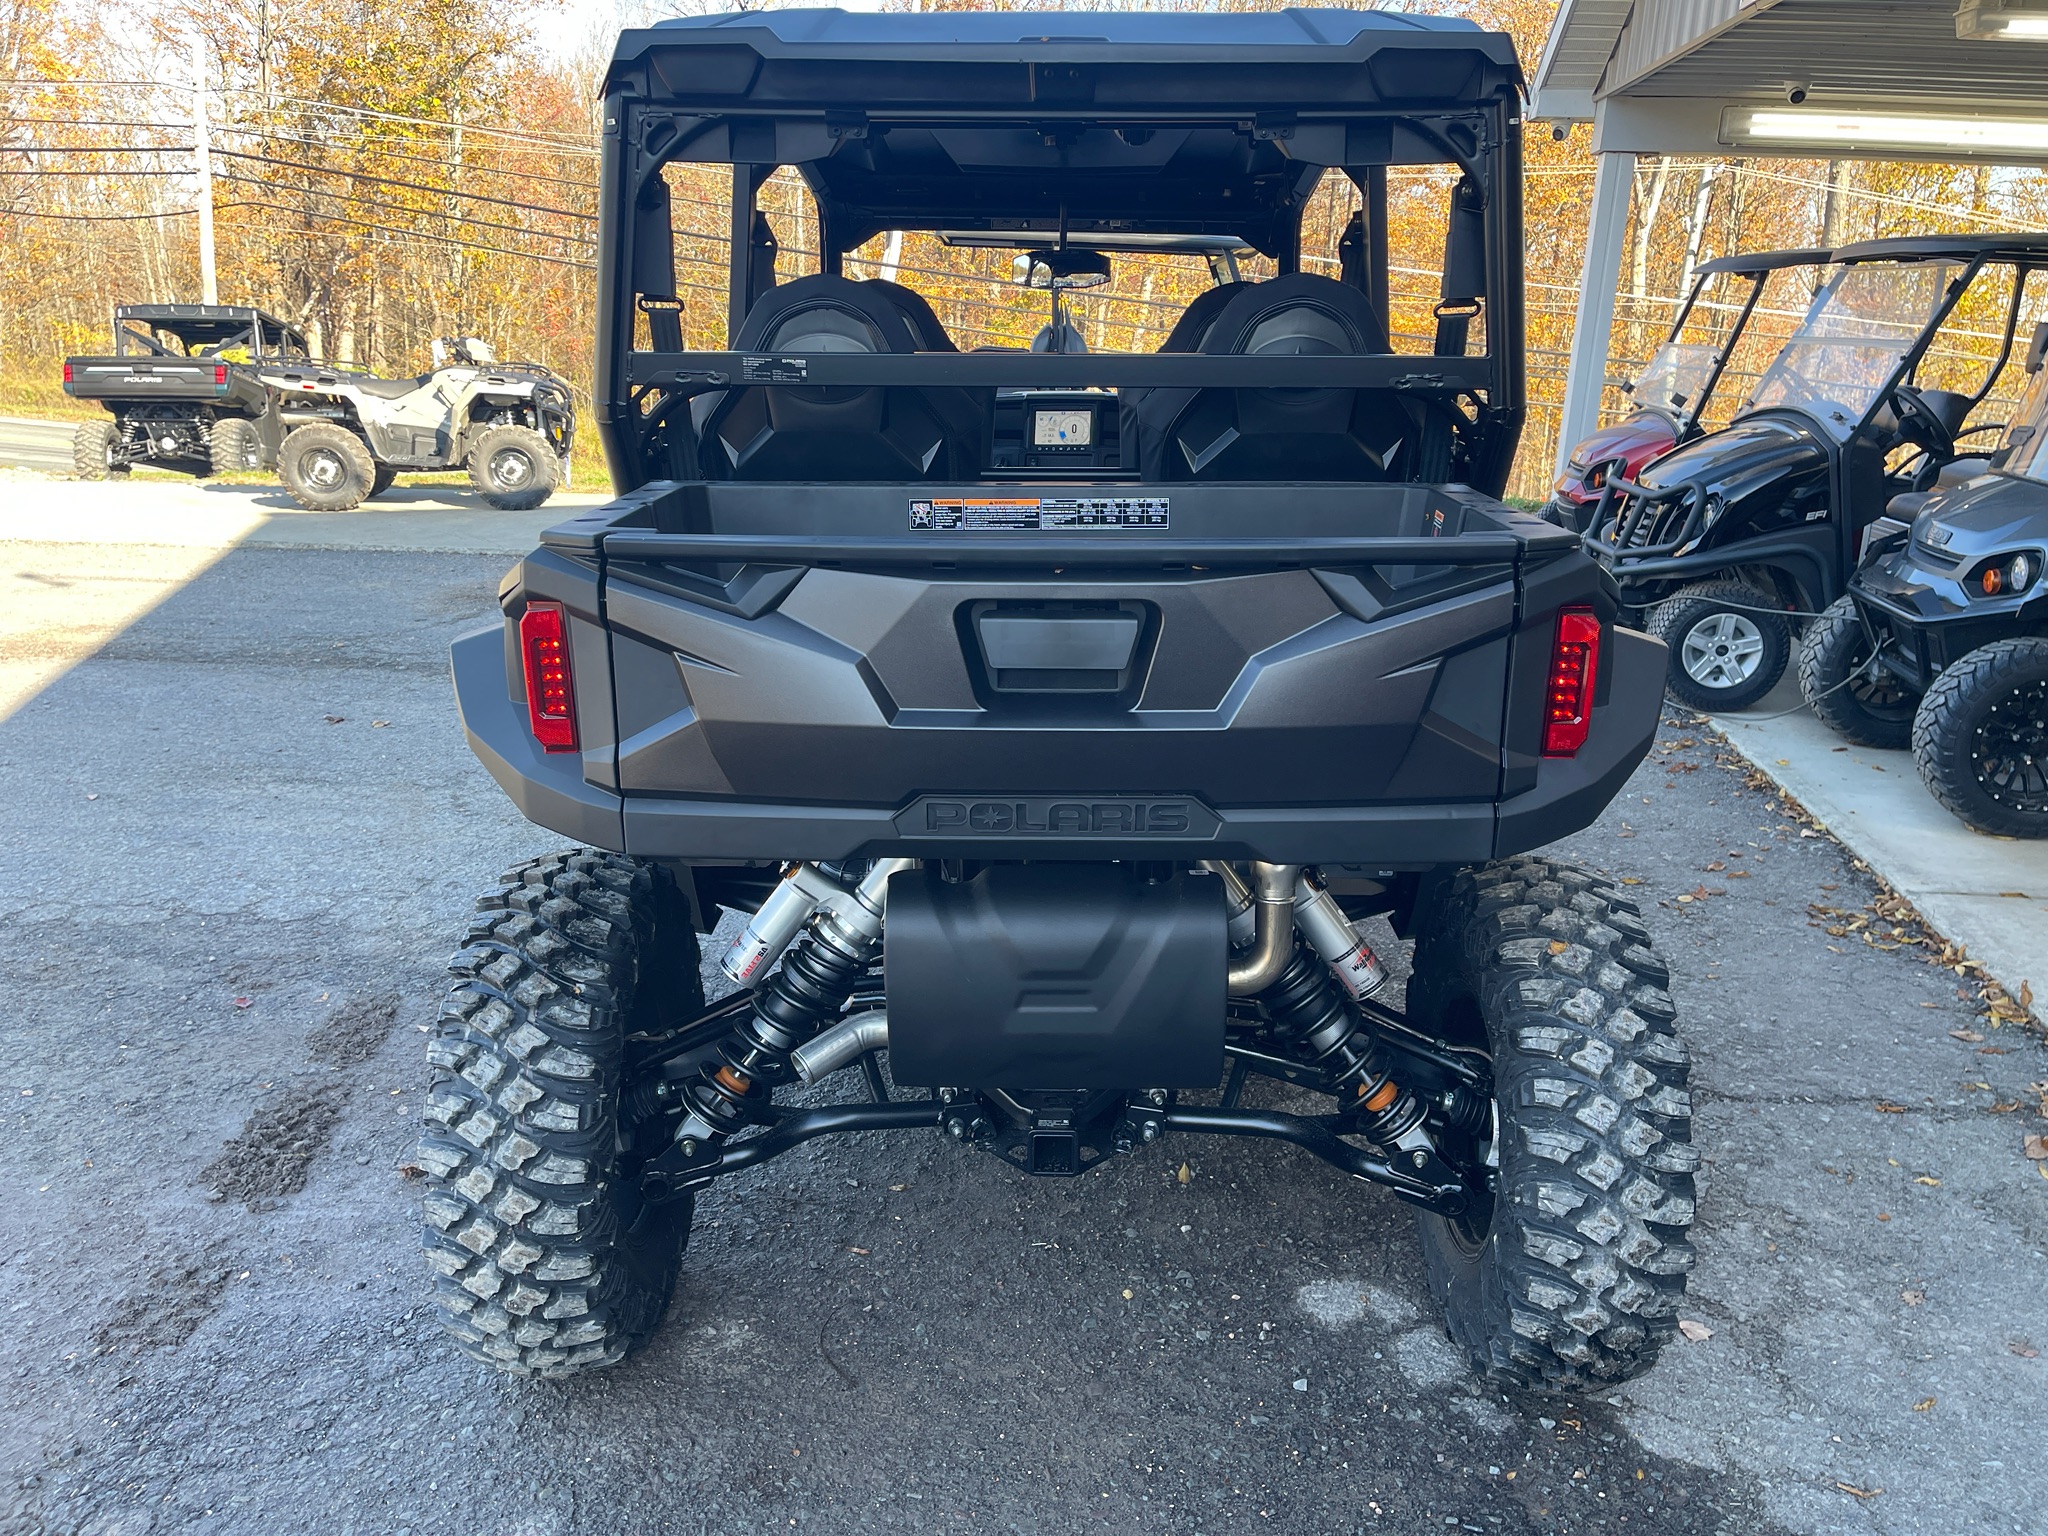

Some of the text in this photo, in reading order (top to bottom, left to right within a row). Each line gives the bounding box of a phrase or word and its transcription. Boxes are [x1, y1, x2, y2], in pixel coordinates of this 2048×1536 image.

[1071, 423, 1077, 434] 0
[1805, 509, 1828, 521] EFI
[926, 802, 1190, 833] POLARIS
